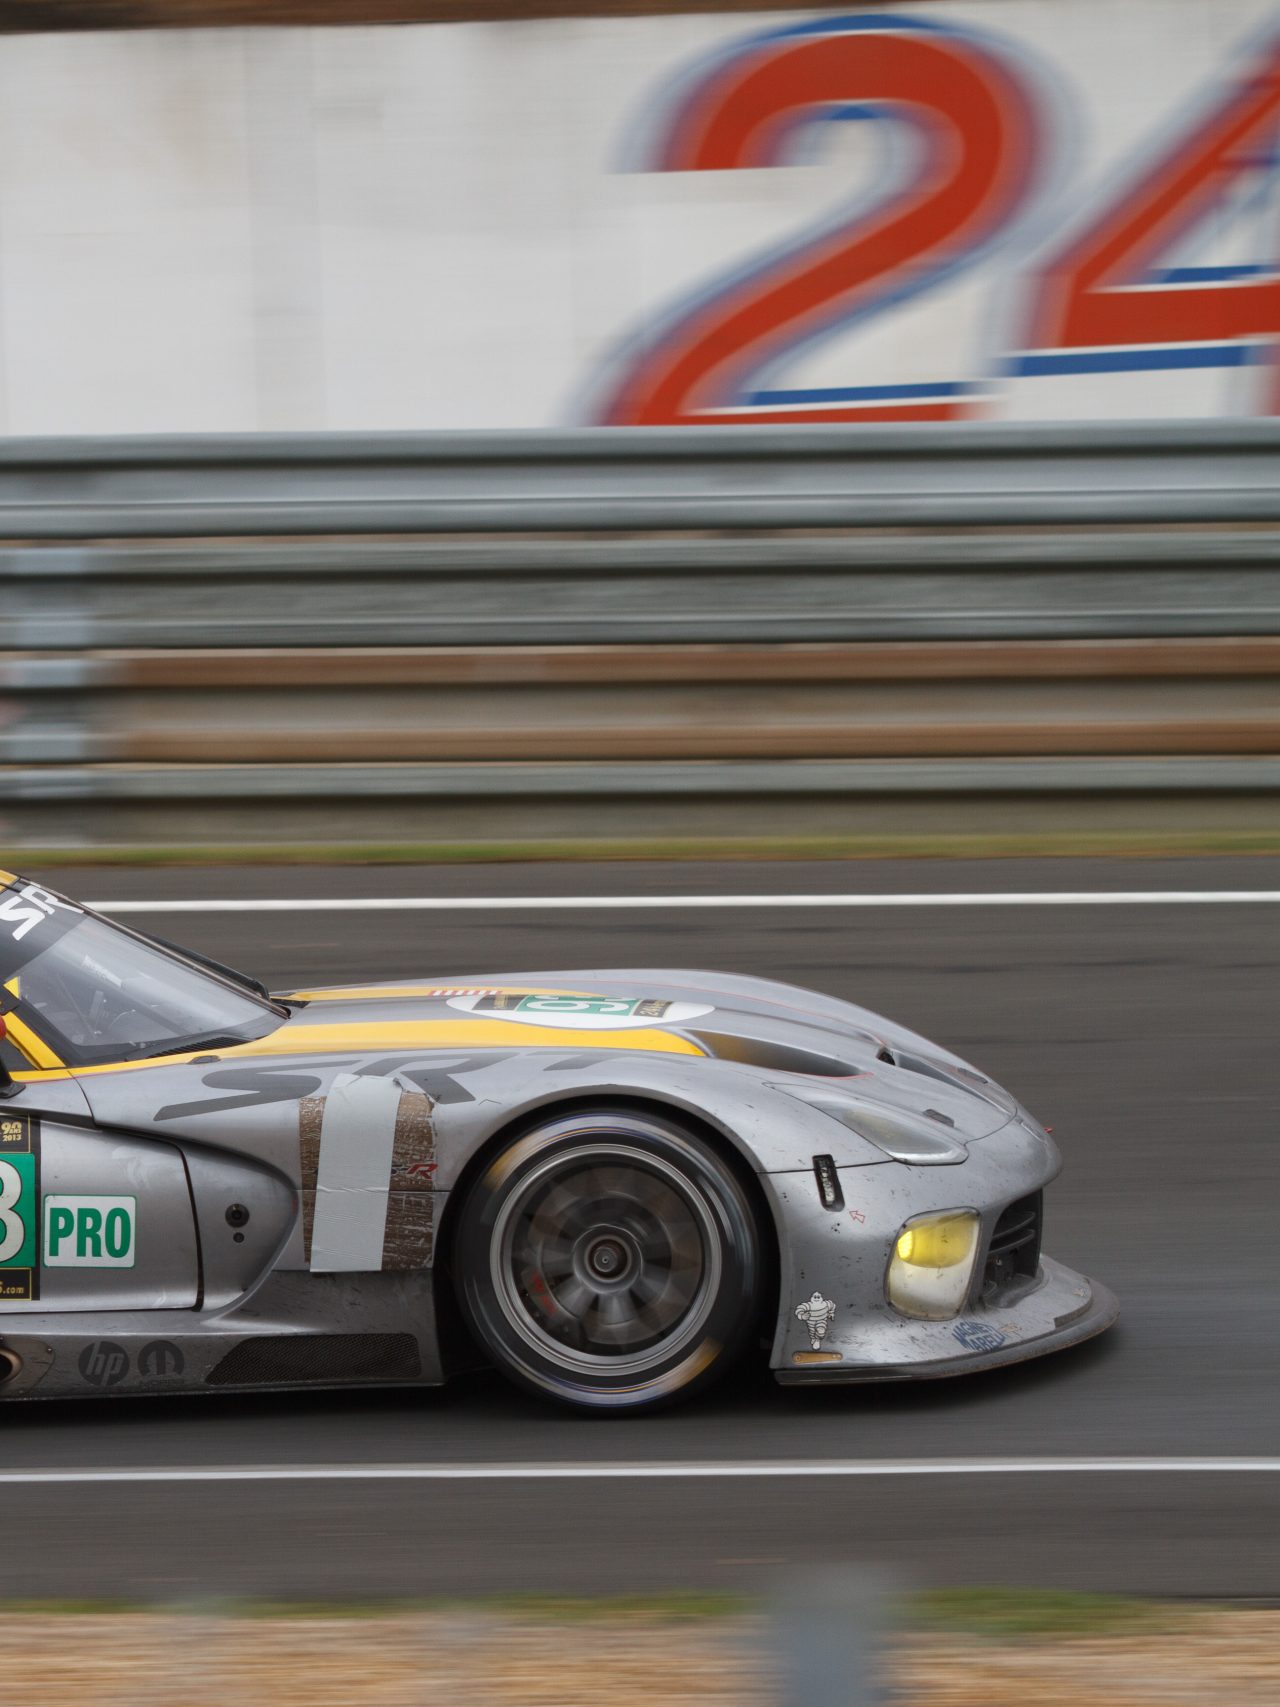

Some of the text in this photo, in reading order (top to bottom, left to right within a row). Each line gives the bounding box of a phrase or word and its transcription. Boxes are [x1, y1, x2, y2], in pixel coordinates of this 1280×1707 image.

[2, 1134, 22, 1142] 2013
[49, 1207, 131, 1258] PRO
[85, 1340, 125, 1387] hp
